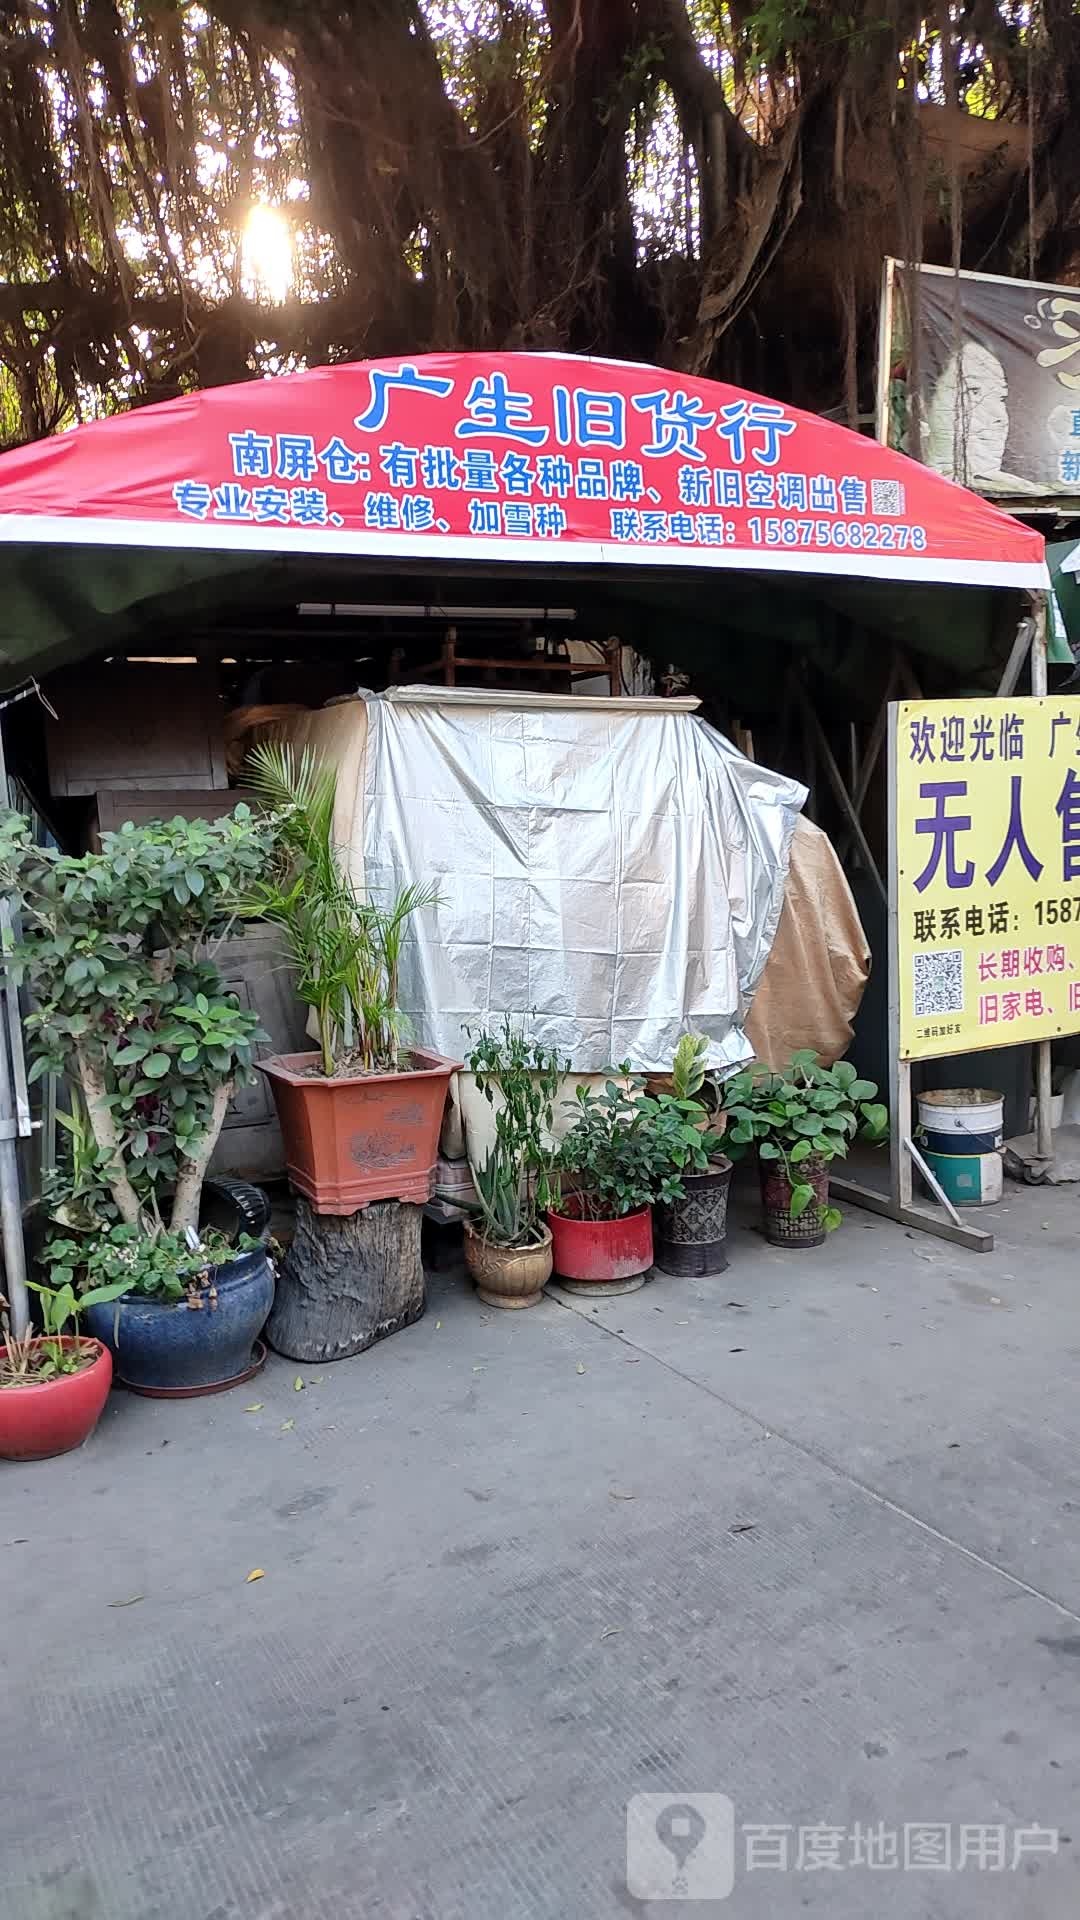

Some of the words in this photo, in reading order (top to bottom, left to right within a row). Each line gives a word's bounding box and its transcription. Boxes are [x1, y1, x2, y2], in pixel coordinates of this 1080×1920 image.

[354, 364, 797, 464] 广生旧货行
[909, 712, 1024, 765] 欢迎光临
[1049, 711, 1080, 758] 广
